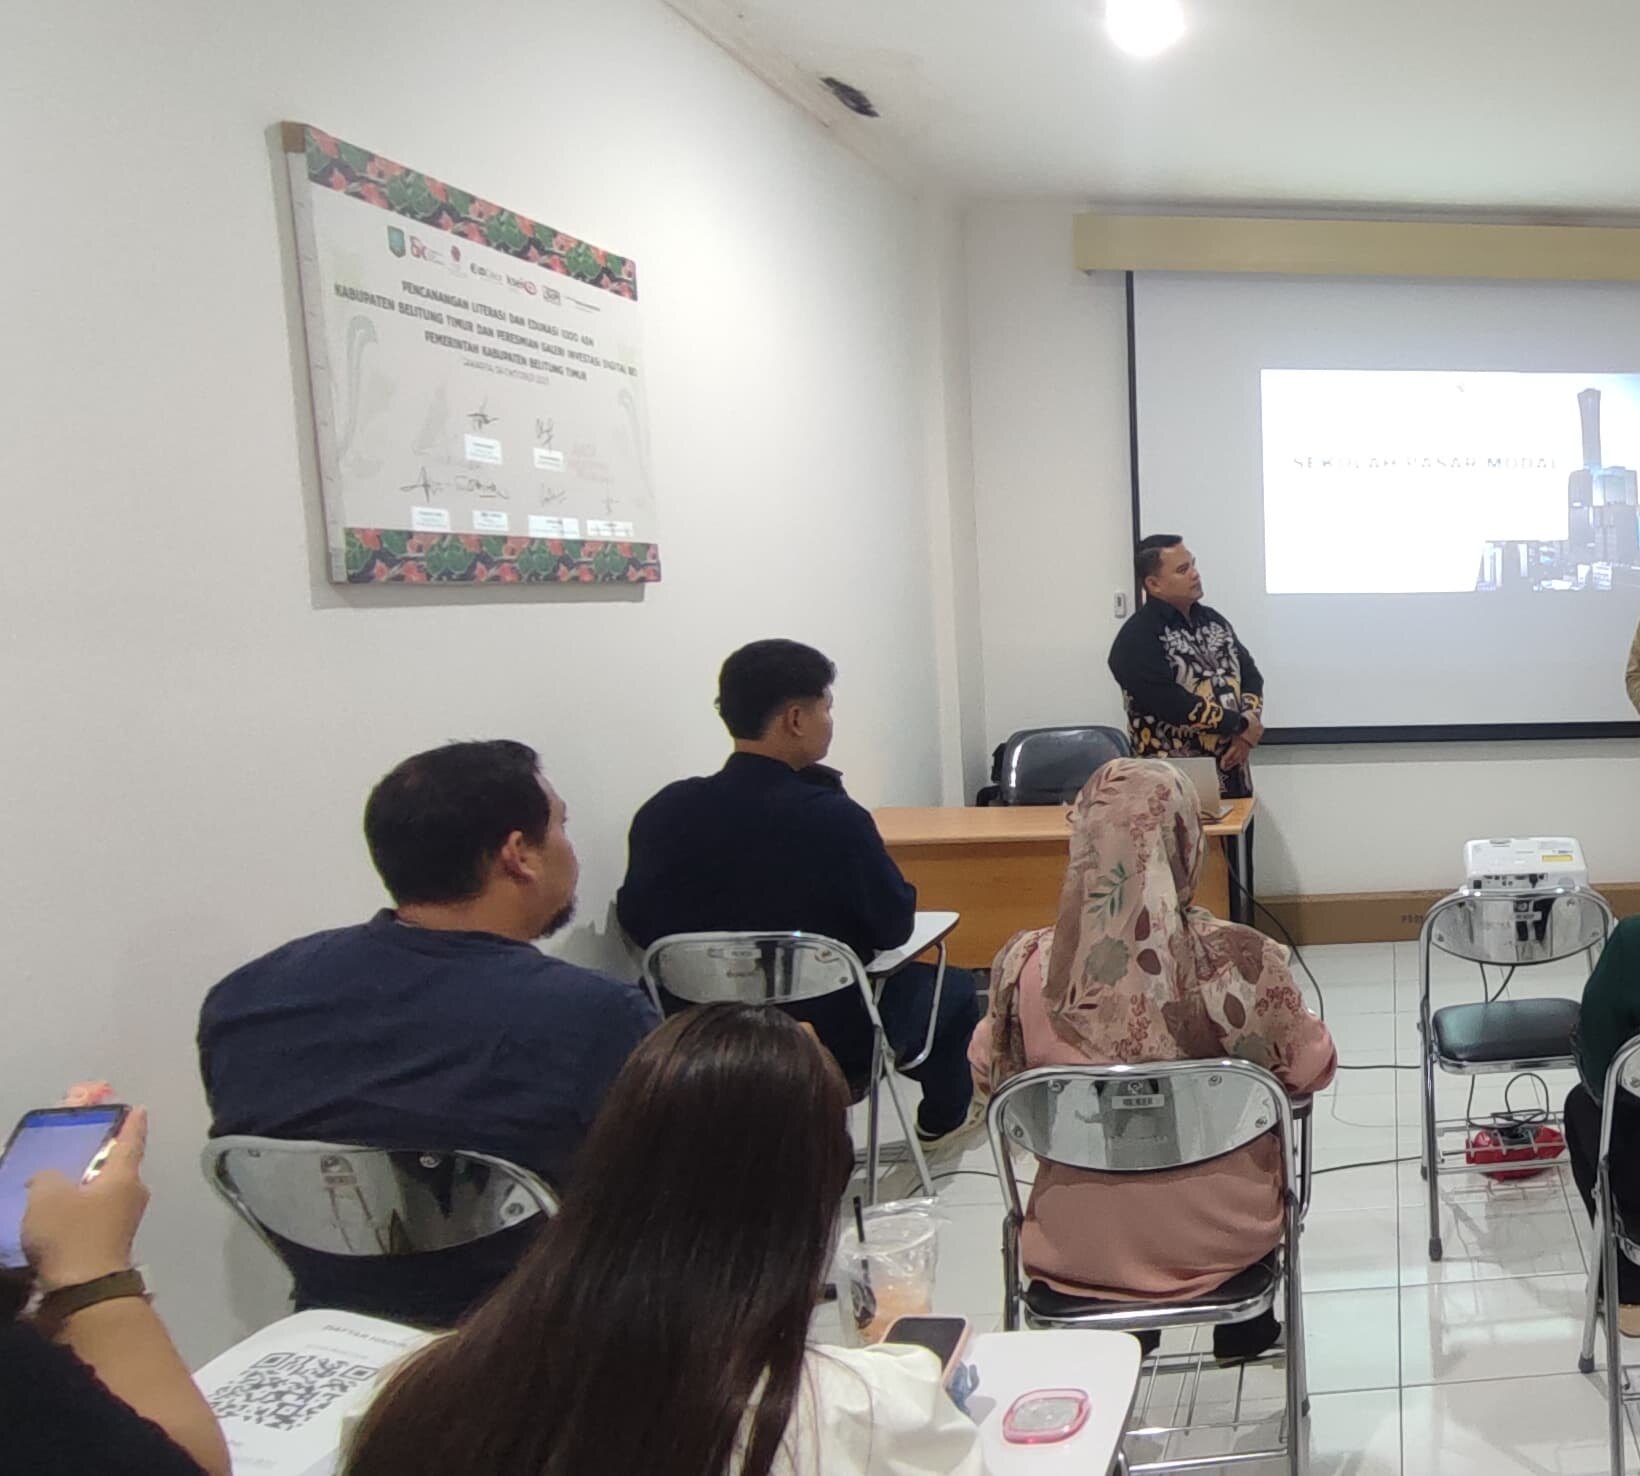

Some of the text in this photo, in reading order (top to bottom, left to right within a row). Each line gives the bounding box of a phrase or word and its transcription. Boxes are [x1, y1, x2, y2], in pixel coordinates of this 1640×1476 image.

[334, 283, 395, 311] KABUPATEN
[398, 301, 444, 325] BELITUNG
[446, 314, 474, 333] TIMUR
[477, 323, 494, 338] DAN
[496, 329, 539, 350] PERESMIAN
[541, 341, 565, 358] GALERI
[402, 280, 469, 310] PENCANANGAN
[472, 302, 506, 322] LITERASI
[509, 311, 525, 327] DAN
[528, 318, 560, 336] EDUKASI
[424, 330, 588, 382] PEMERINTAH KABUPATEN BELITUNG TIMUR
